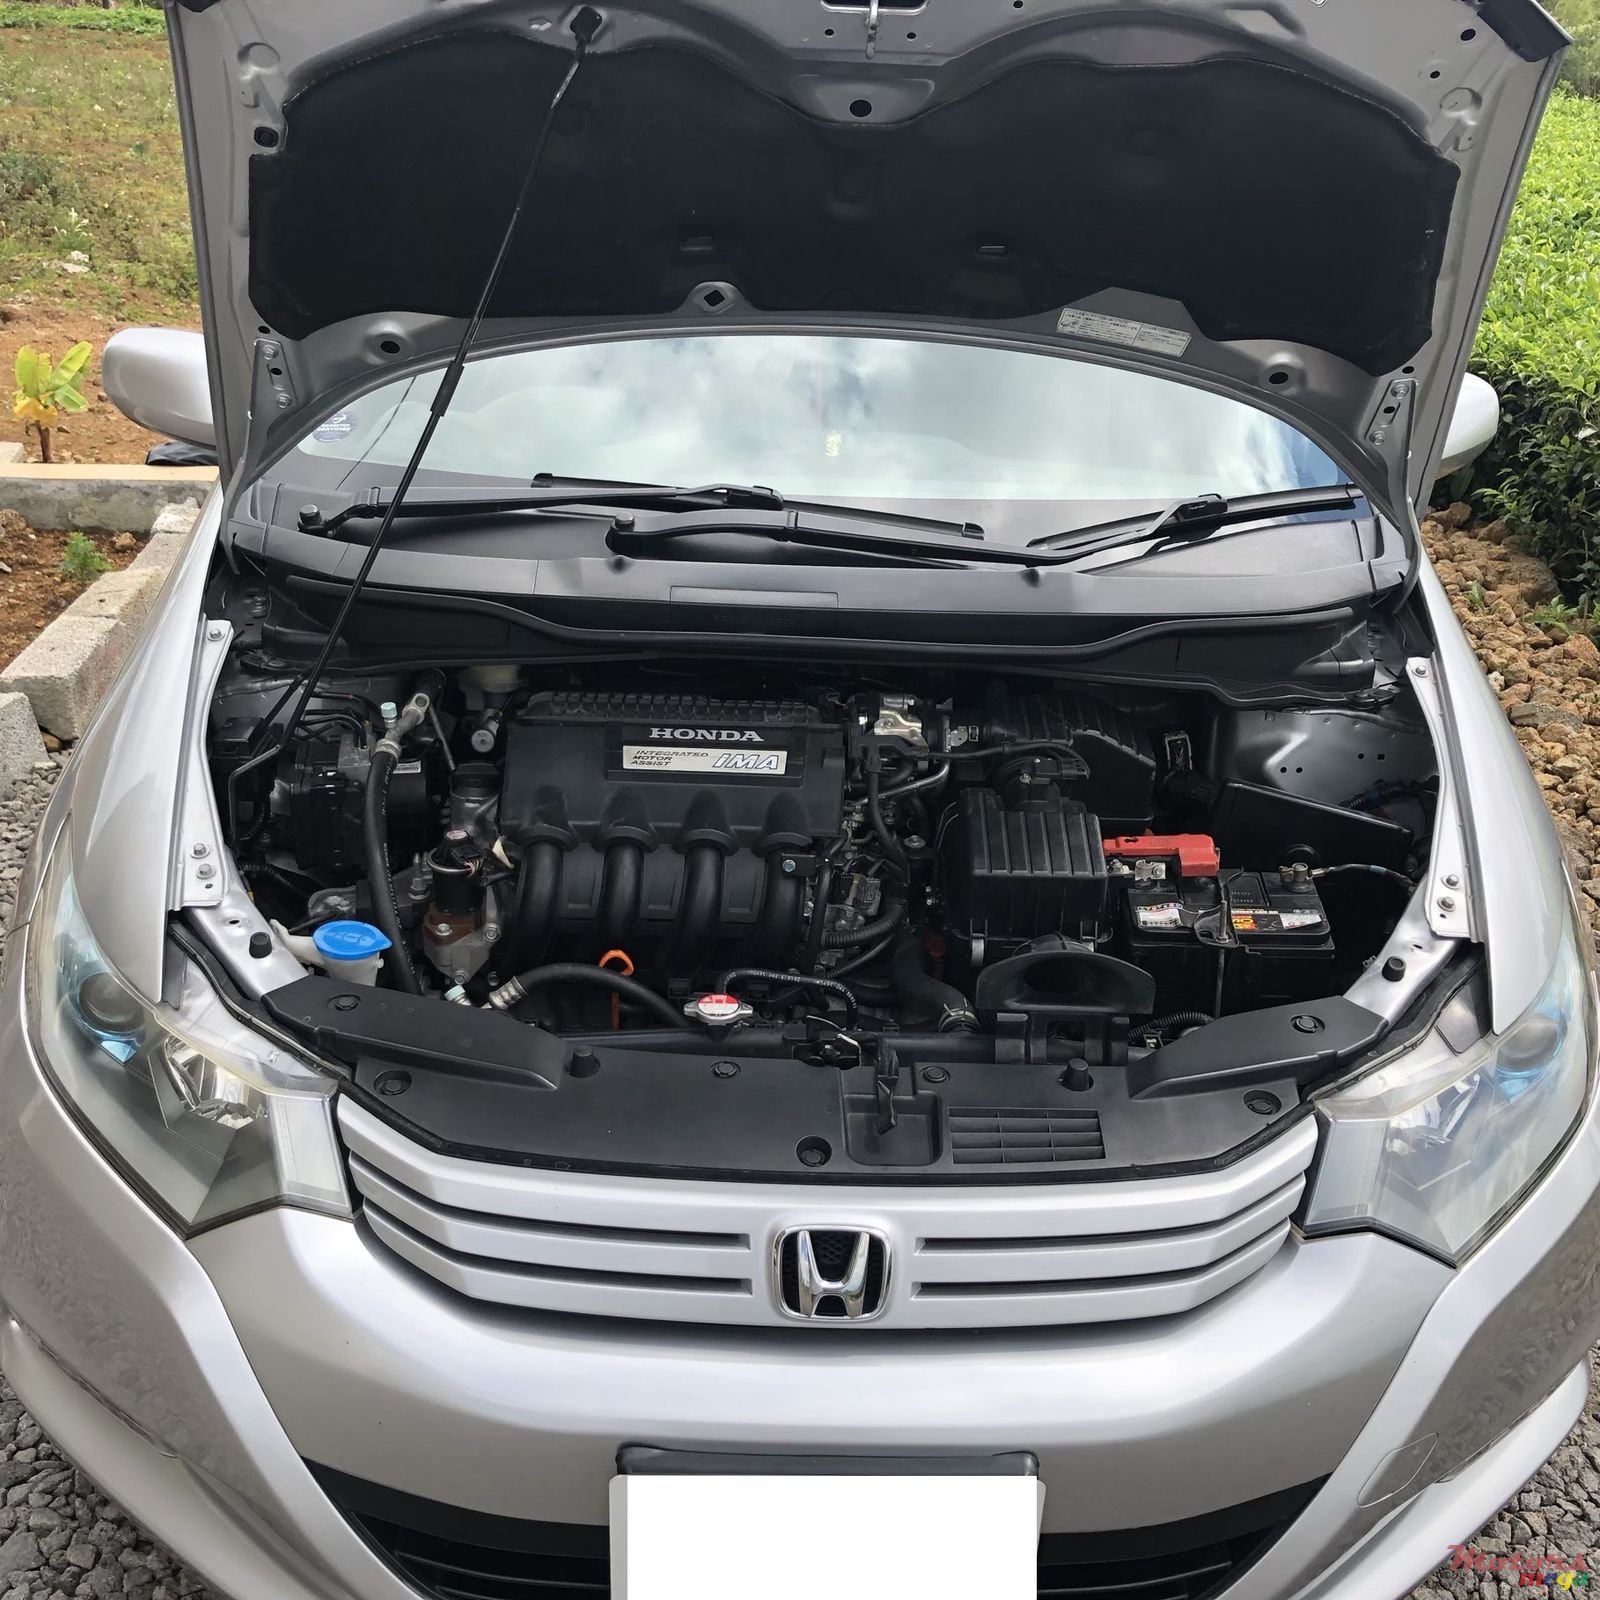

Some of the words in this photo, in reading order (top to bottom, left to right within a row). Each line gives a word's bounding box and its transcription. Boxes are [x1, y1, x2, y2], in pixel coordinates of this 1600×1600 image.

[649, 727, 764, 742] HONDA
[635, 750, 709, 758] INTEGRATED
[712, 752, 780, 770] IMA
